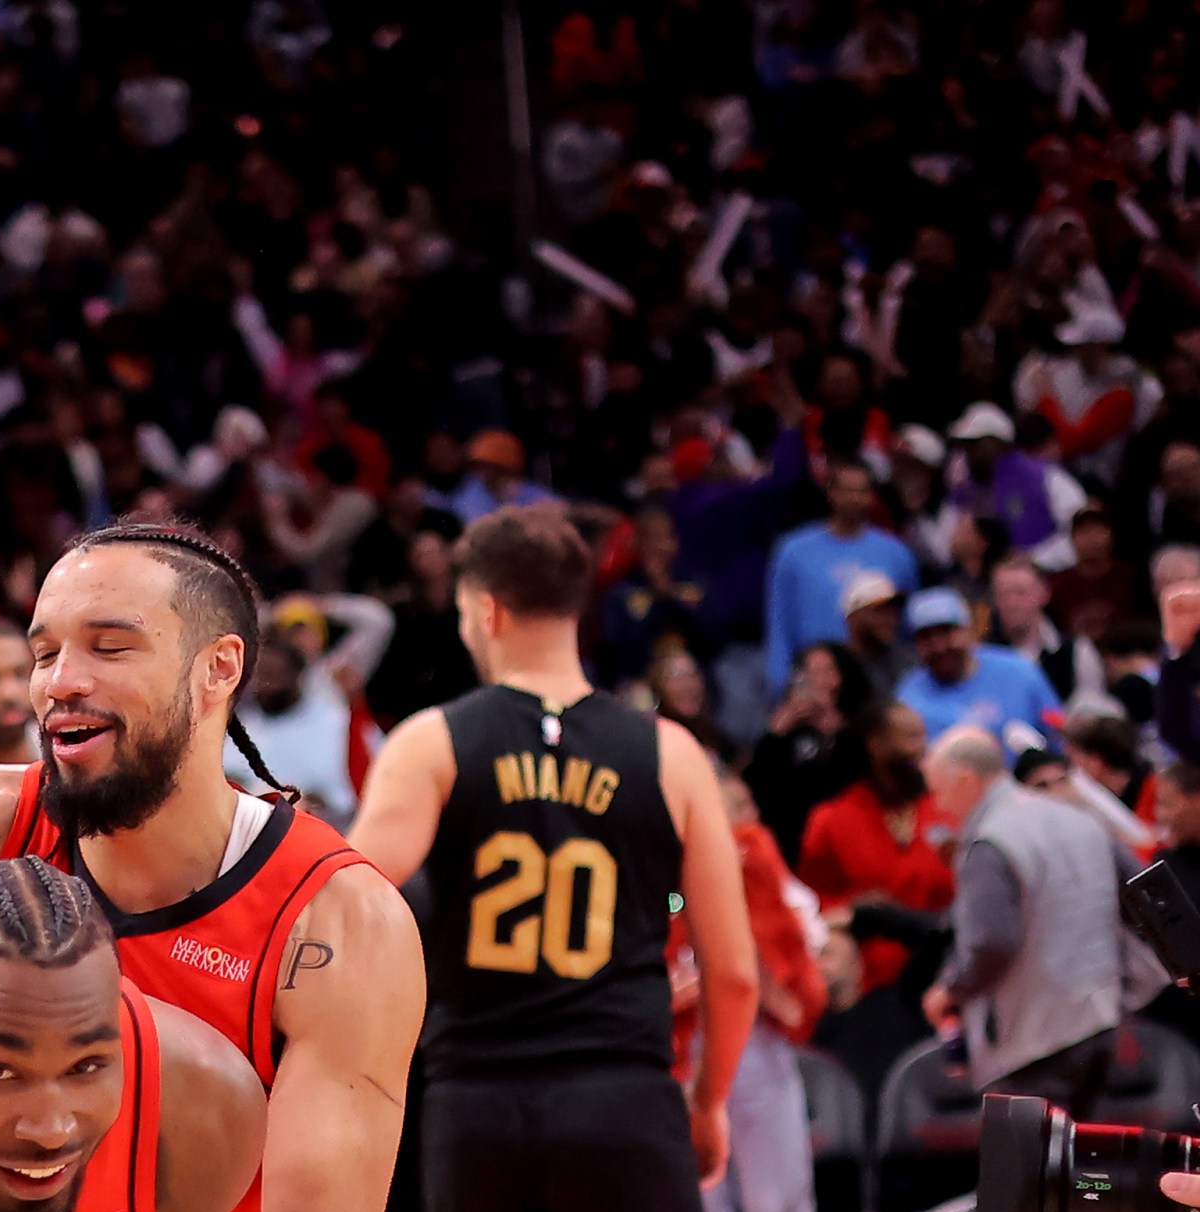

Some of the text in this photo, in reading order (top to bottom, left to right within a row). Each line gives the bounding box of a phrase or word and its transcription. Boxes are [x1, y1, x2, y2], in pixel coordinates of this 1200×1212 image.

[494, 751, 620, 815] NIANG
[467, 831, 619, 980] 20
[170, 948, 250, 982] HERMANN
[173, 936, 250, 974] MEMORIAL
[280, 937, 333, 990] P
